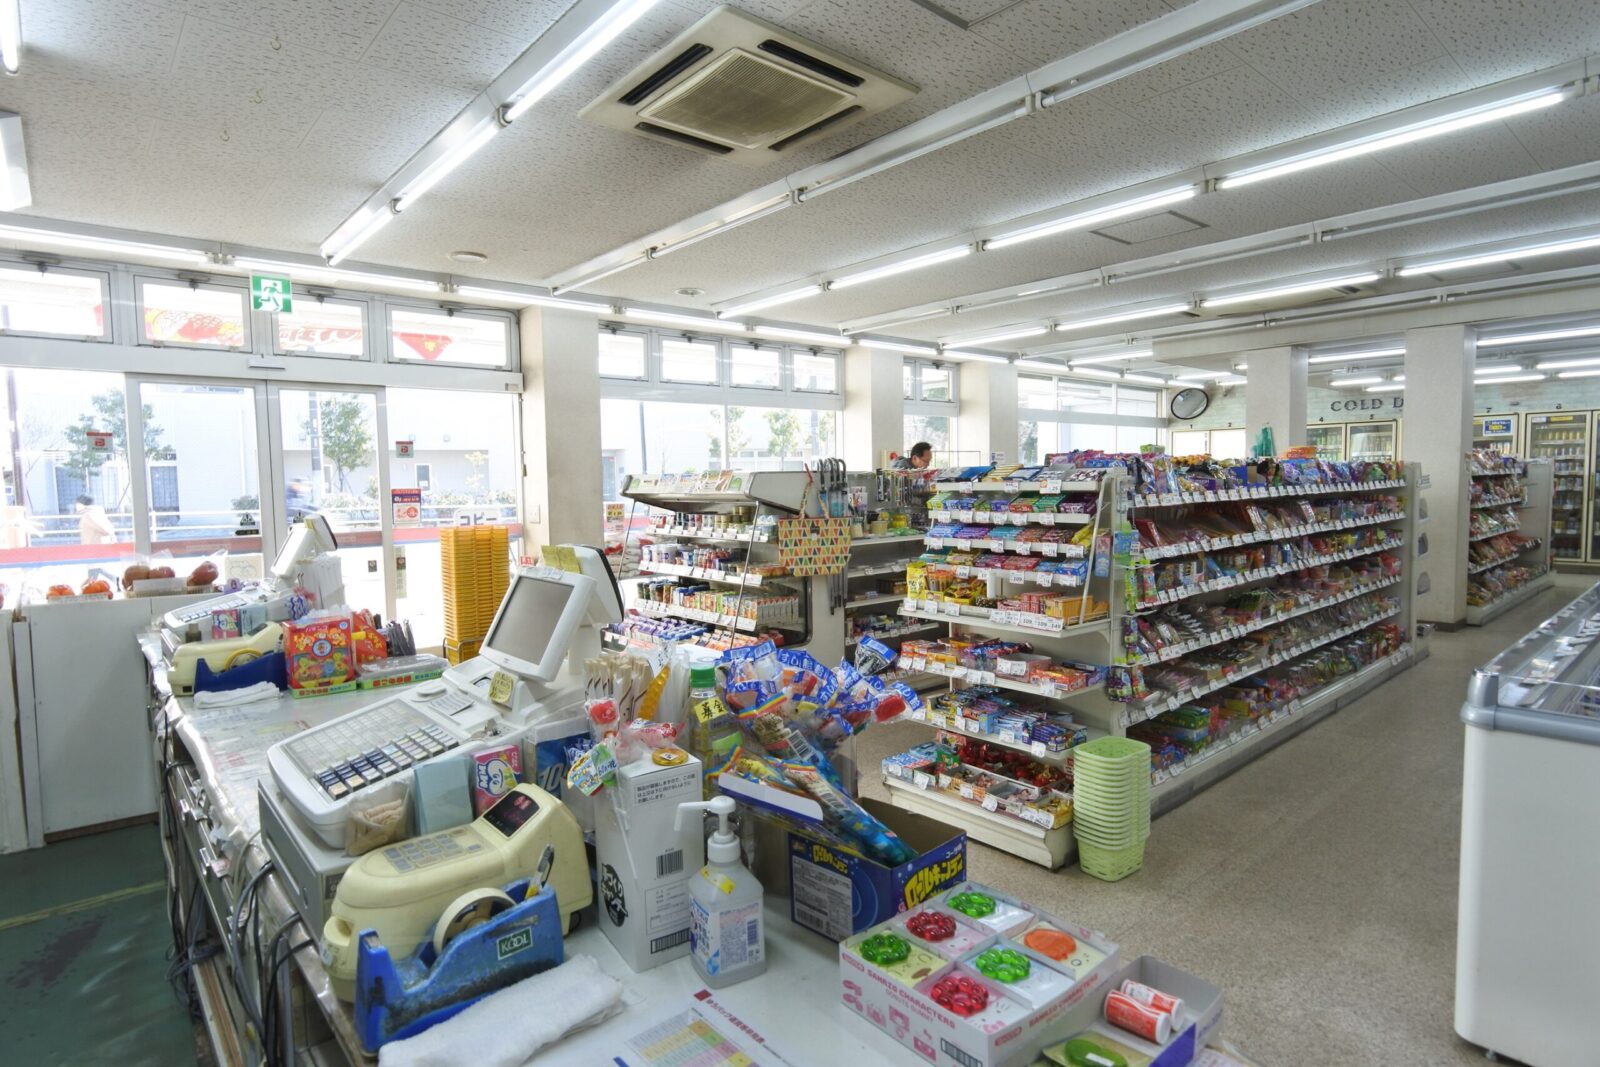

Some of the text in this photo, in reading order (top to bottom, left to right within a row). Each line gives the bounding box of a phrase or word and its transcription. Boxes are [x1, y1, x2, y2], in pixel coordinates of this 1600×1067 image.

[1330, 399, 1383, 412] COLD
[867, 969, 956, 1029] SANRIO CHARACTERS
